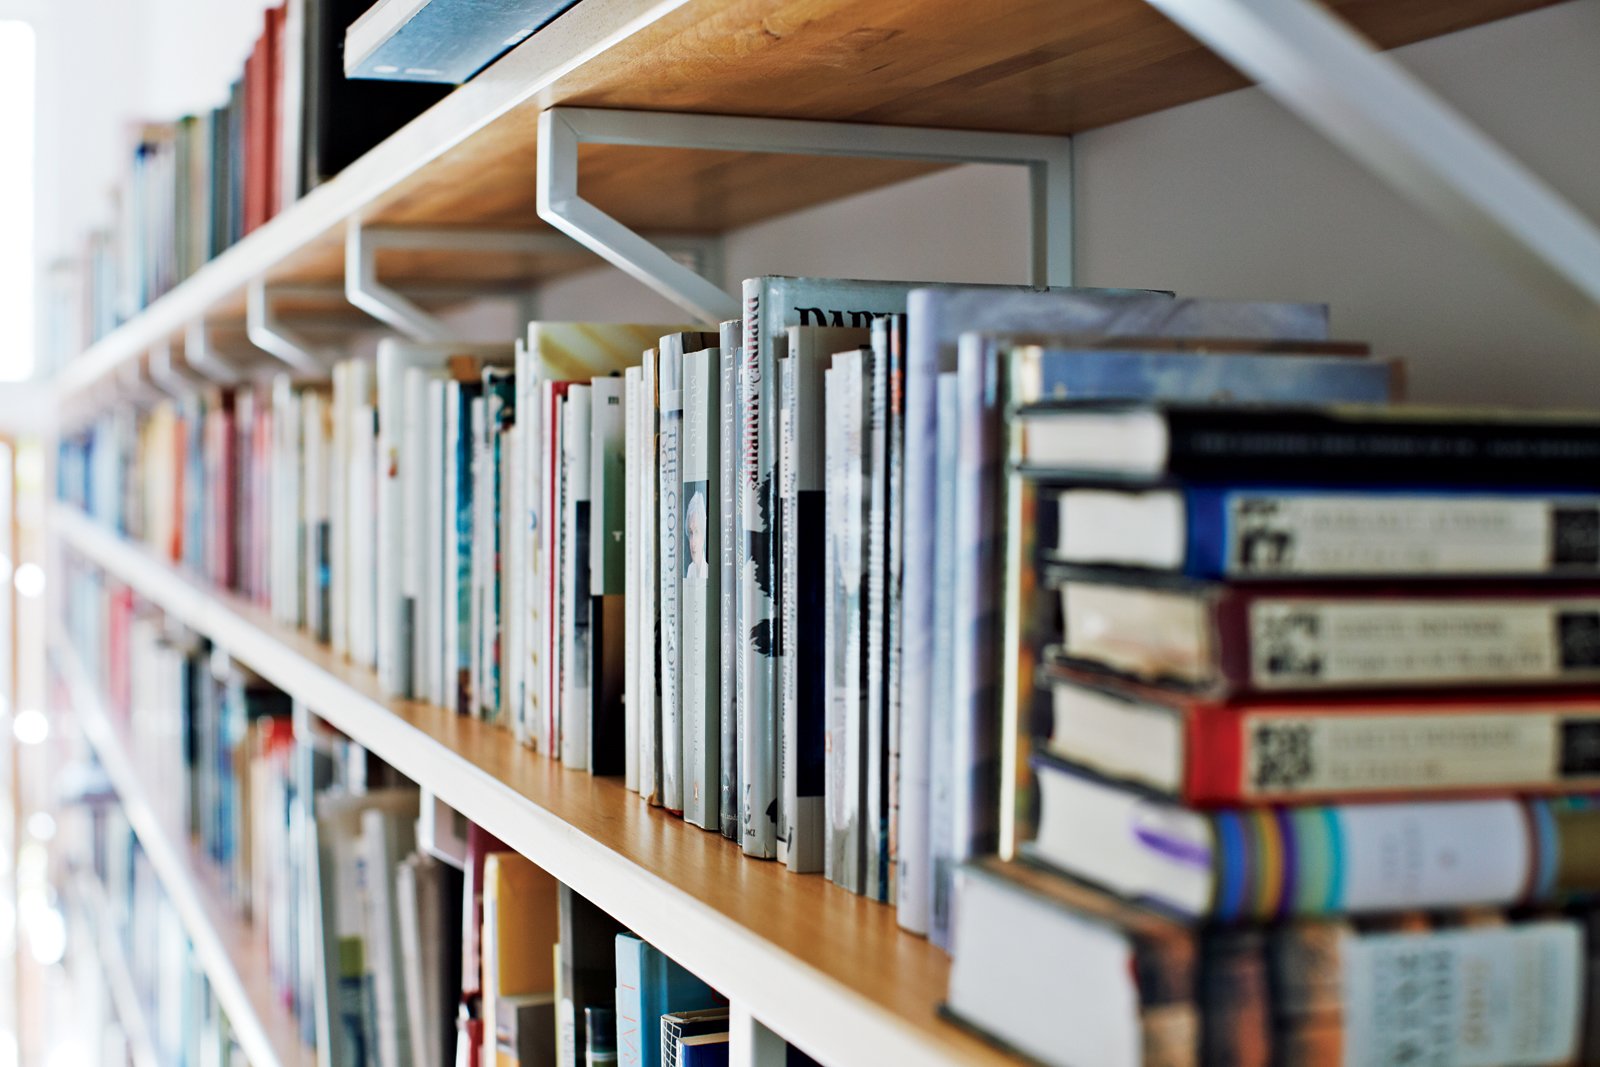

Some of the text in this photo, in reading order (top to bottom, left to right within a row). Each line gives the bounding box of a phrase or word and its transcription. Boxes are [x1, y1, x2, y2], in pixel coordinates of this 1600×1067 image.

[747, 296, 760, 373] DAPHNE
[667, 427, 677, 484] THE
[724, 347, 733, 568] The Electrical Field
[667, 490, 677, 573] GOOD
[723, 592, 732, 735] Kerri Sakamoto
